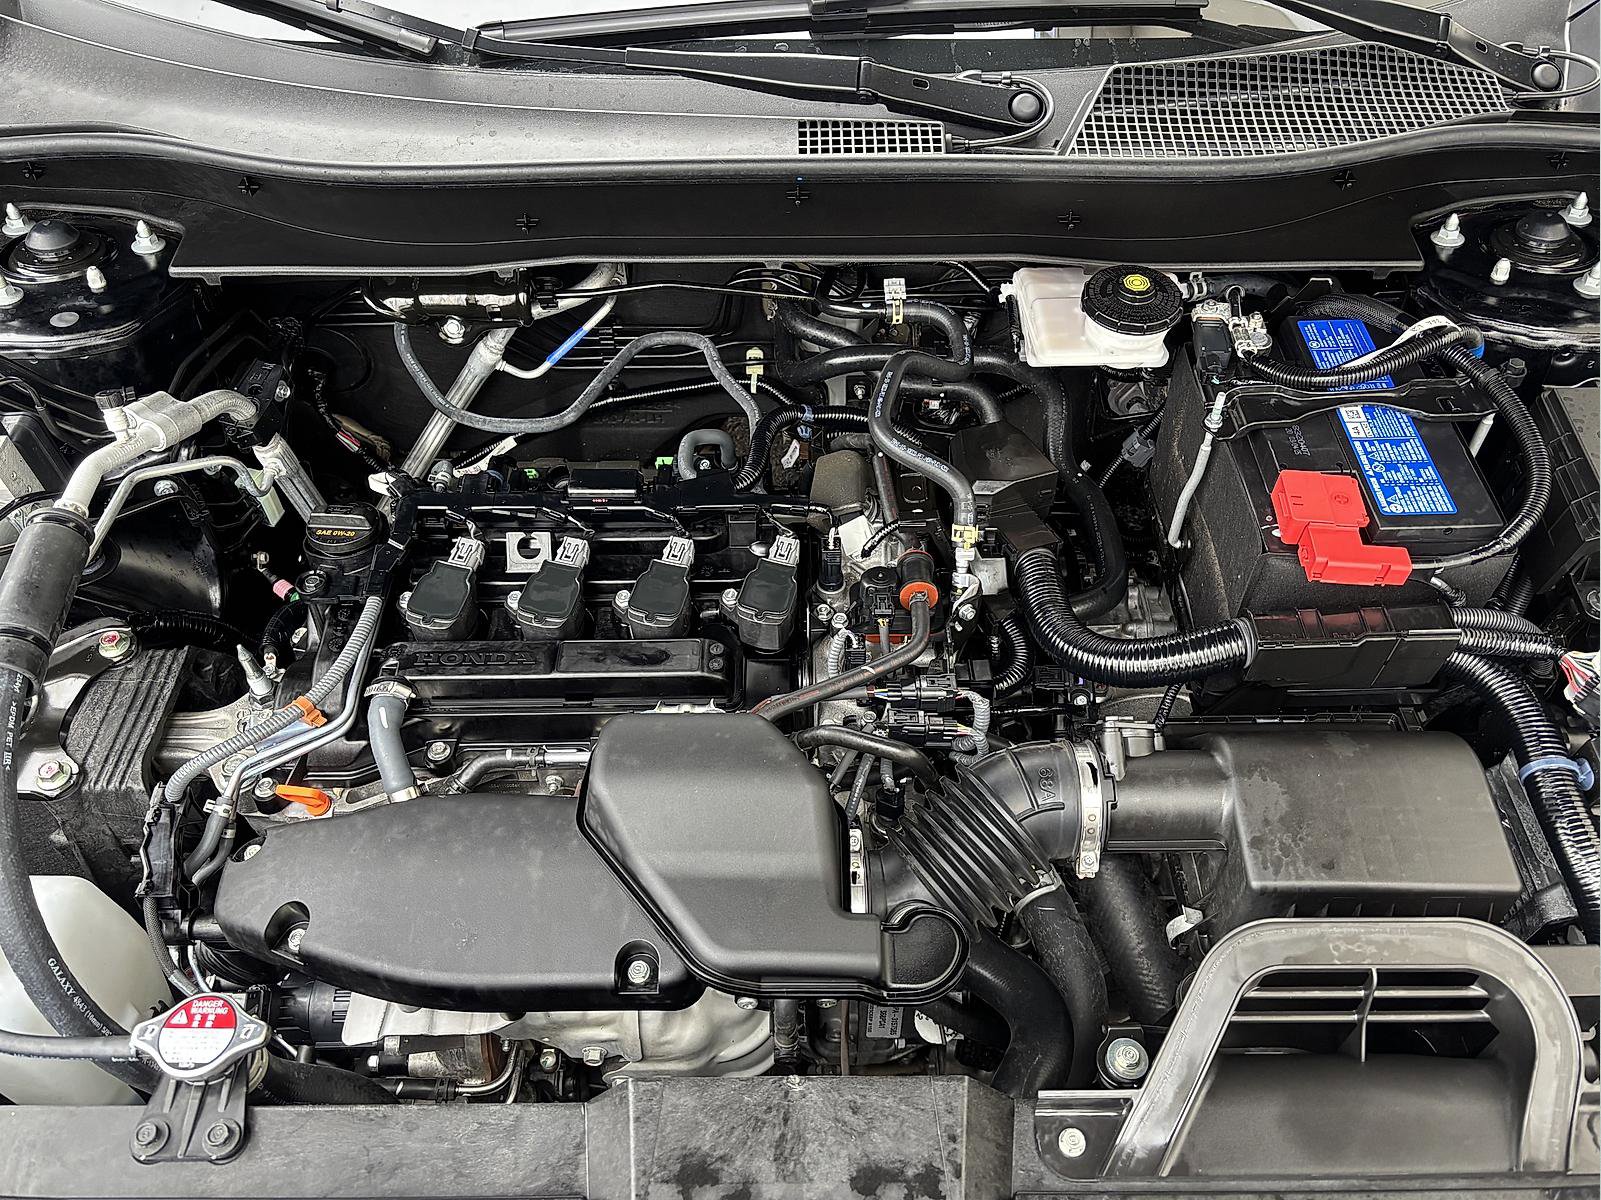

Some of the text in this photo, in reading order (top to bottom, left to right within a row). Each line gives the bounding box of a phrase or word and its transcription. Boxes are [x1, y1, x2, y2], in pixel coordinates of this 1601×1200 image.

[316, 529, 333, 537] SAE
[414, 651, 536, 666] HONDA
[6, 731, 14, 749] PET
[1038, 767, 1056, 801] 68A
[47, 957, 77, 996] GALAXY
[192, 999, 225, 1008] DANGER
